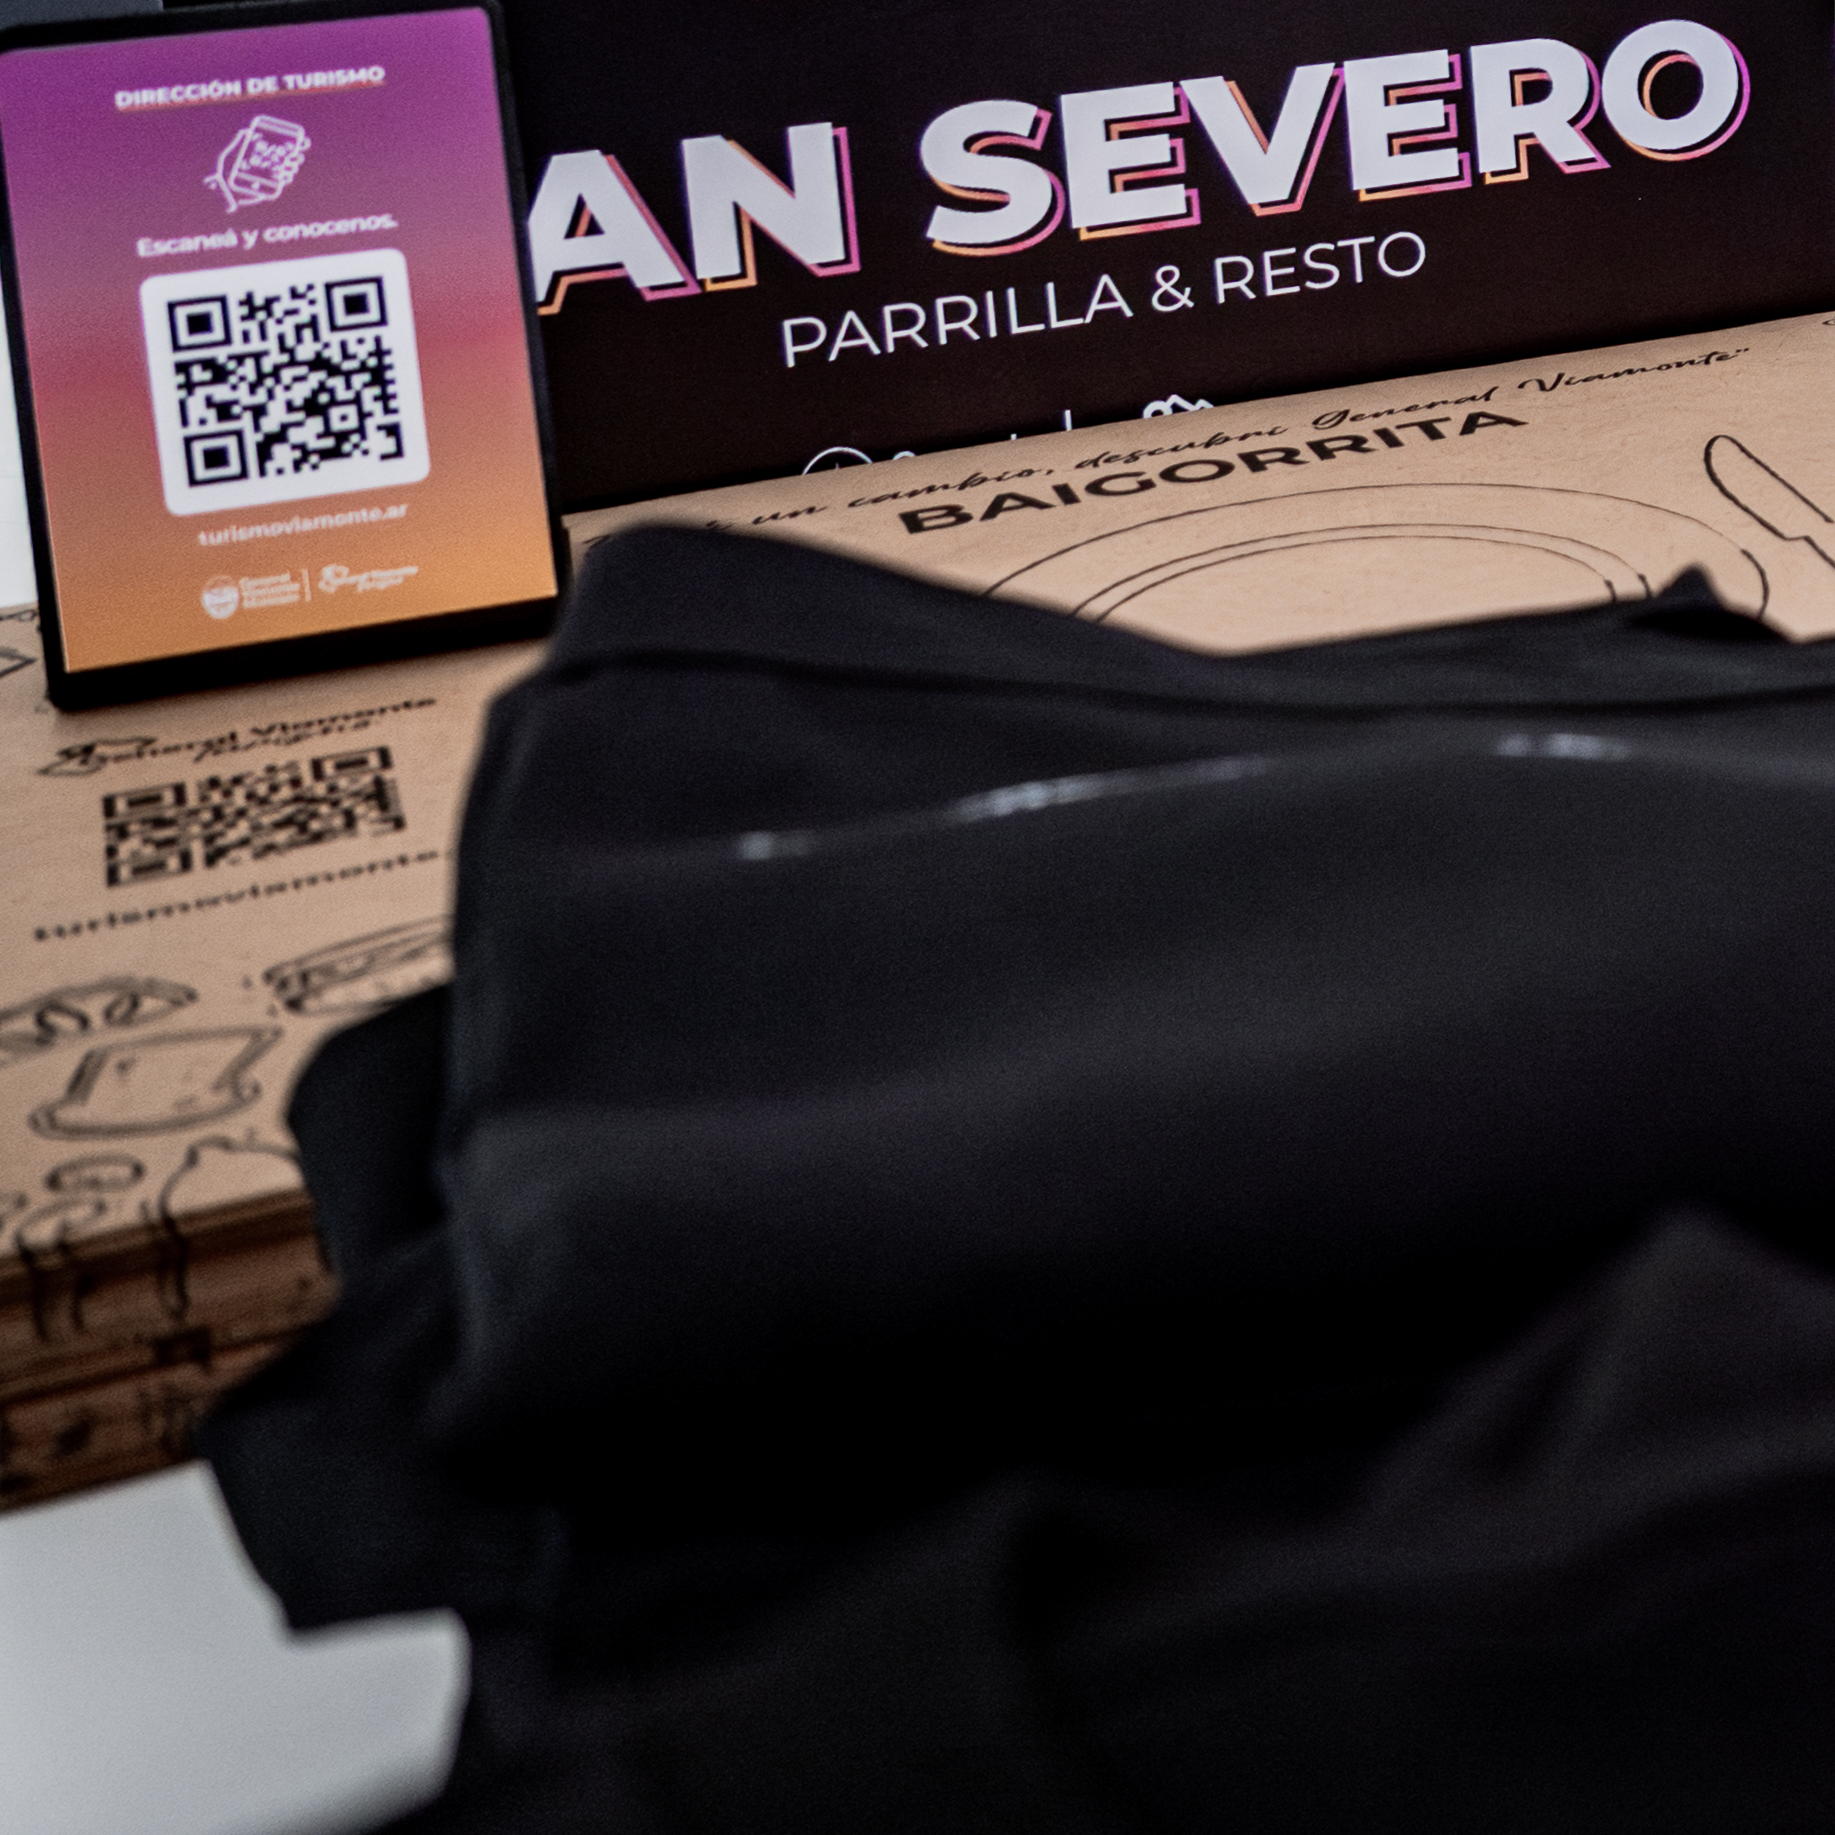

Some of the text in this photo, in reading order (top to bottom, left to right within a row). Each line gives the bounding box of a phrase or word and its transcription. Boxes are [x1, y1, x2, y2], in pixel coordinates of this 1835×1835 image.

[115, 65, 386, 108] DIRECCIÓN DE TURISMO
[919, 18, 1751, 257] SEVERO
[242, 229, 259, 250] y
[780, 231, 1427, 367] PARRILLA & RESTO
[1311, 386, 1501, 431] General
[899, 410, 1529, 535] BAIGORRITA
